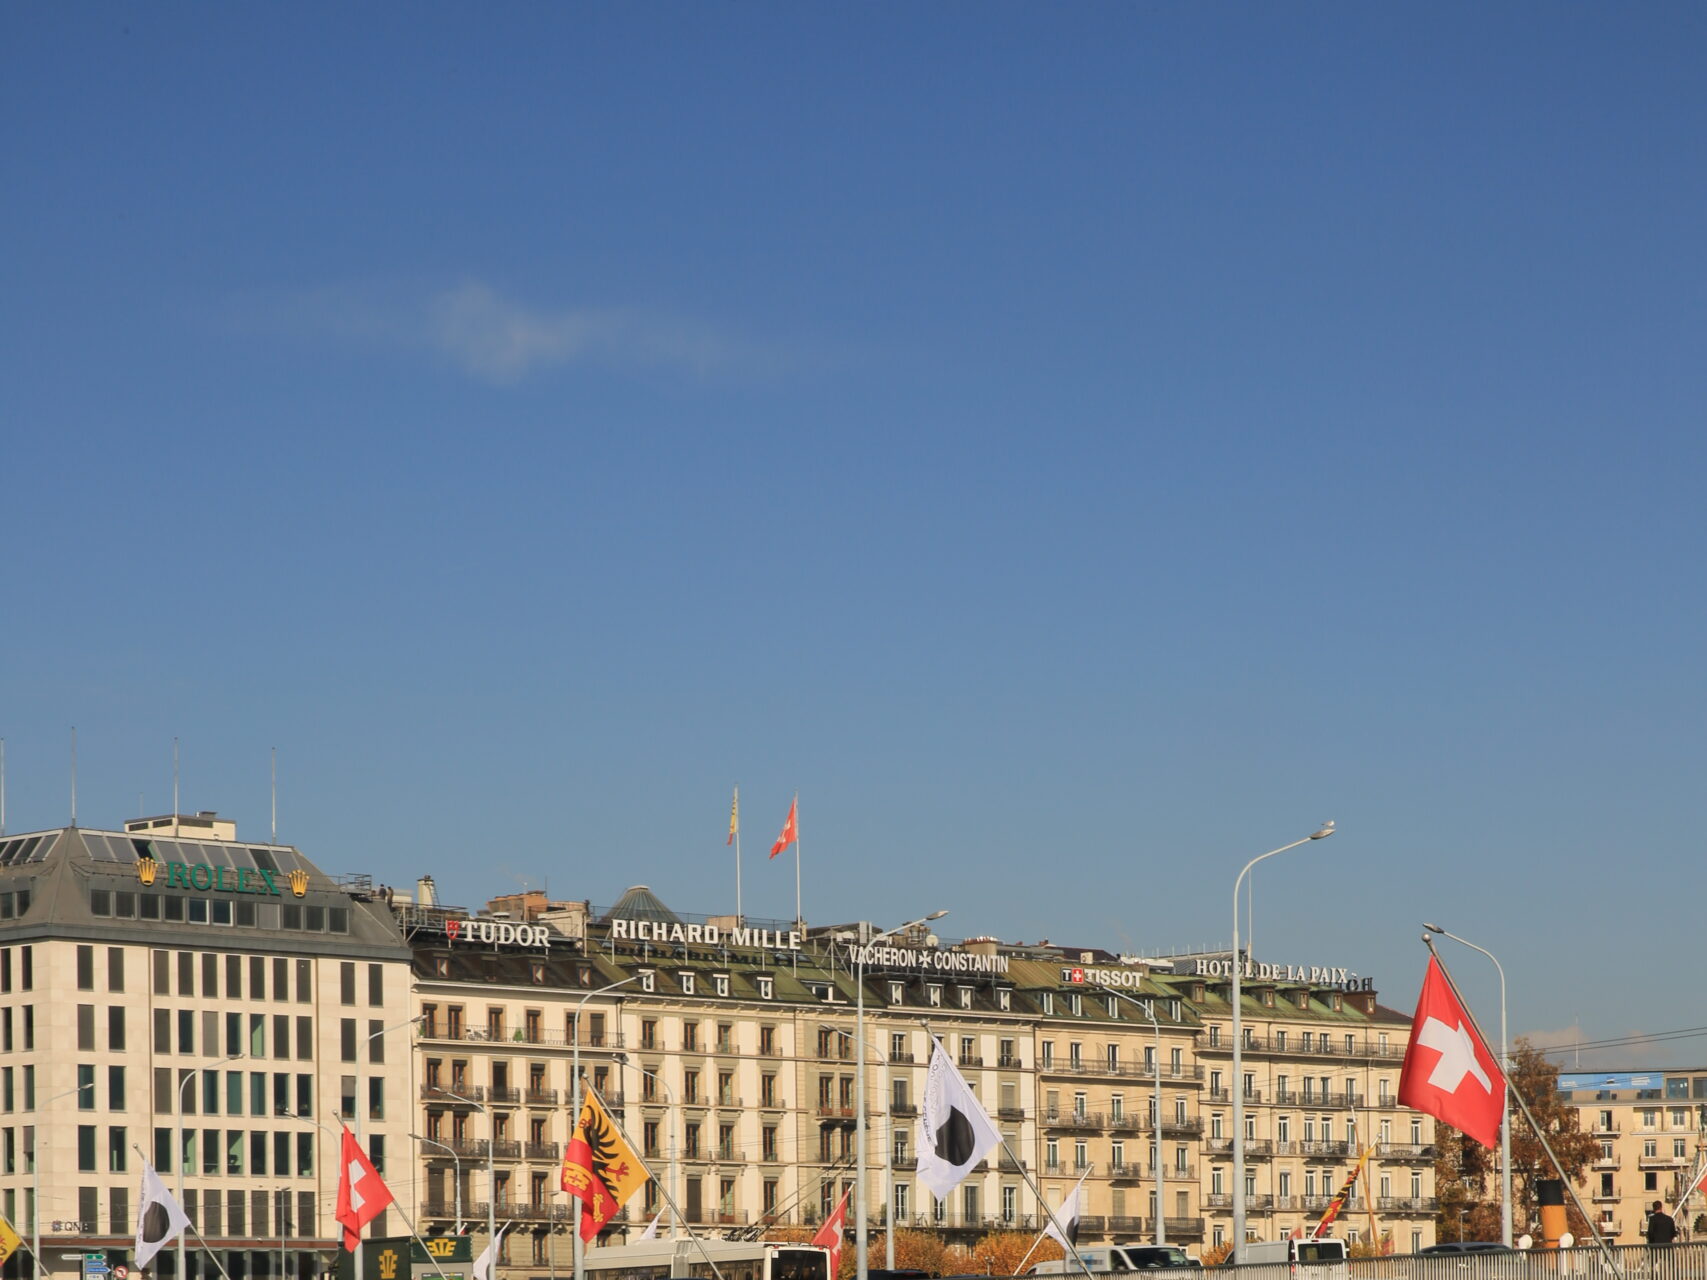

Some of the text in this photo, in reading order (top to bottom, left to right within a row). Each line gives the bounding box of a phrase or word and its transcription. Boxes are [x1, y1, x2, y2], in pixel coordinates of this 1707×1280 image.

[166, 861, 281, 895] ROLEX
[461, 921, 551, 947] TUDOR
[612, 919, 801, 950] RICHARD MILLE
[849, 945, 1009, 973] VACHERON CONSTANTIN
[1084, 968, 1143, 988] TISSOT
[1259, 963, 1282, 980] DE
[1287, 965, 1306, 981] LA
[1310, 966, 1349, 984] PAIX
